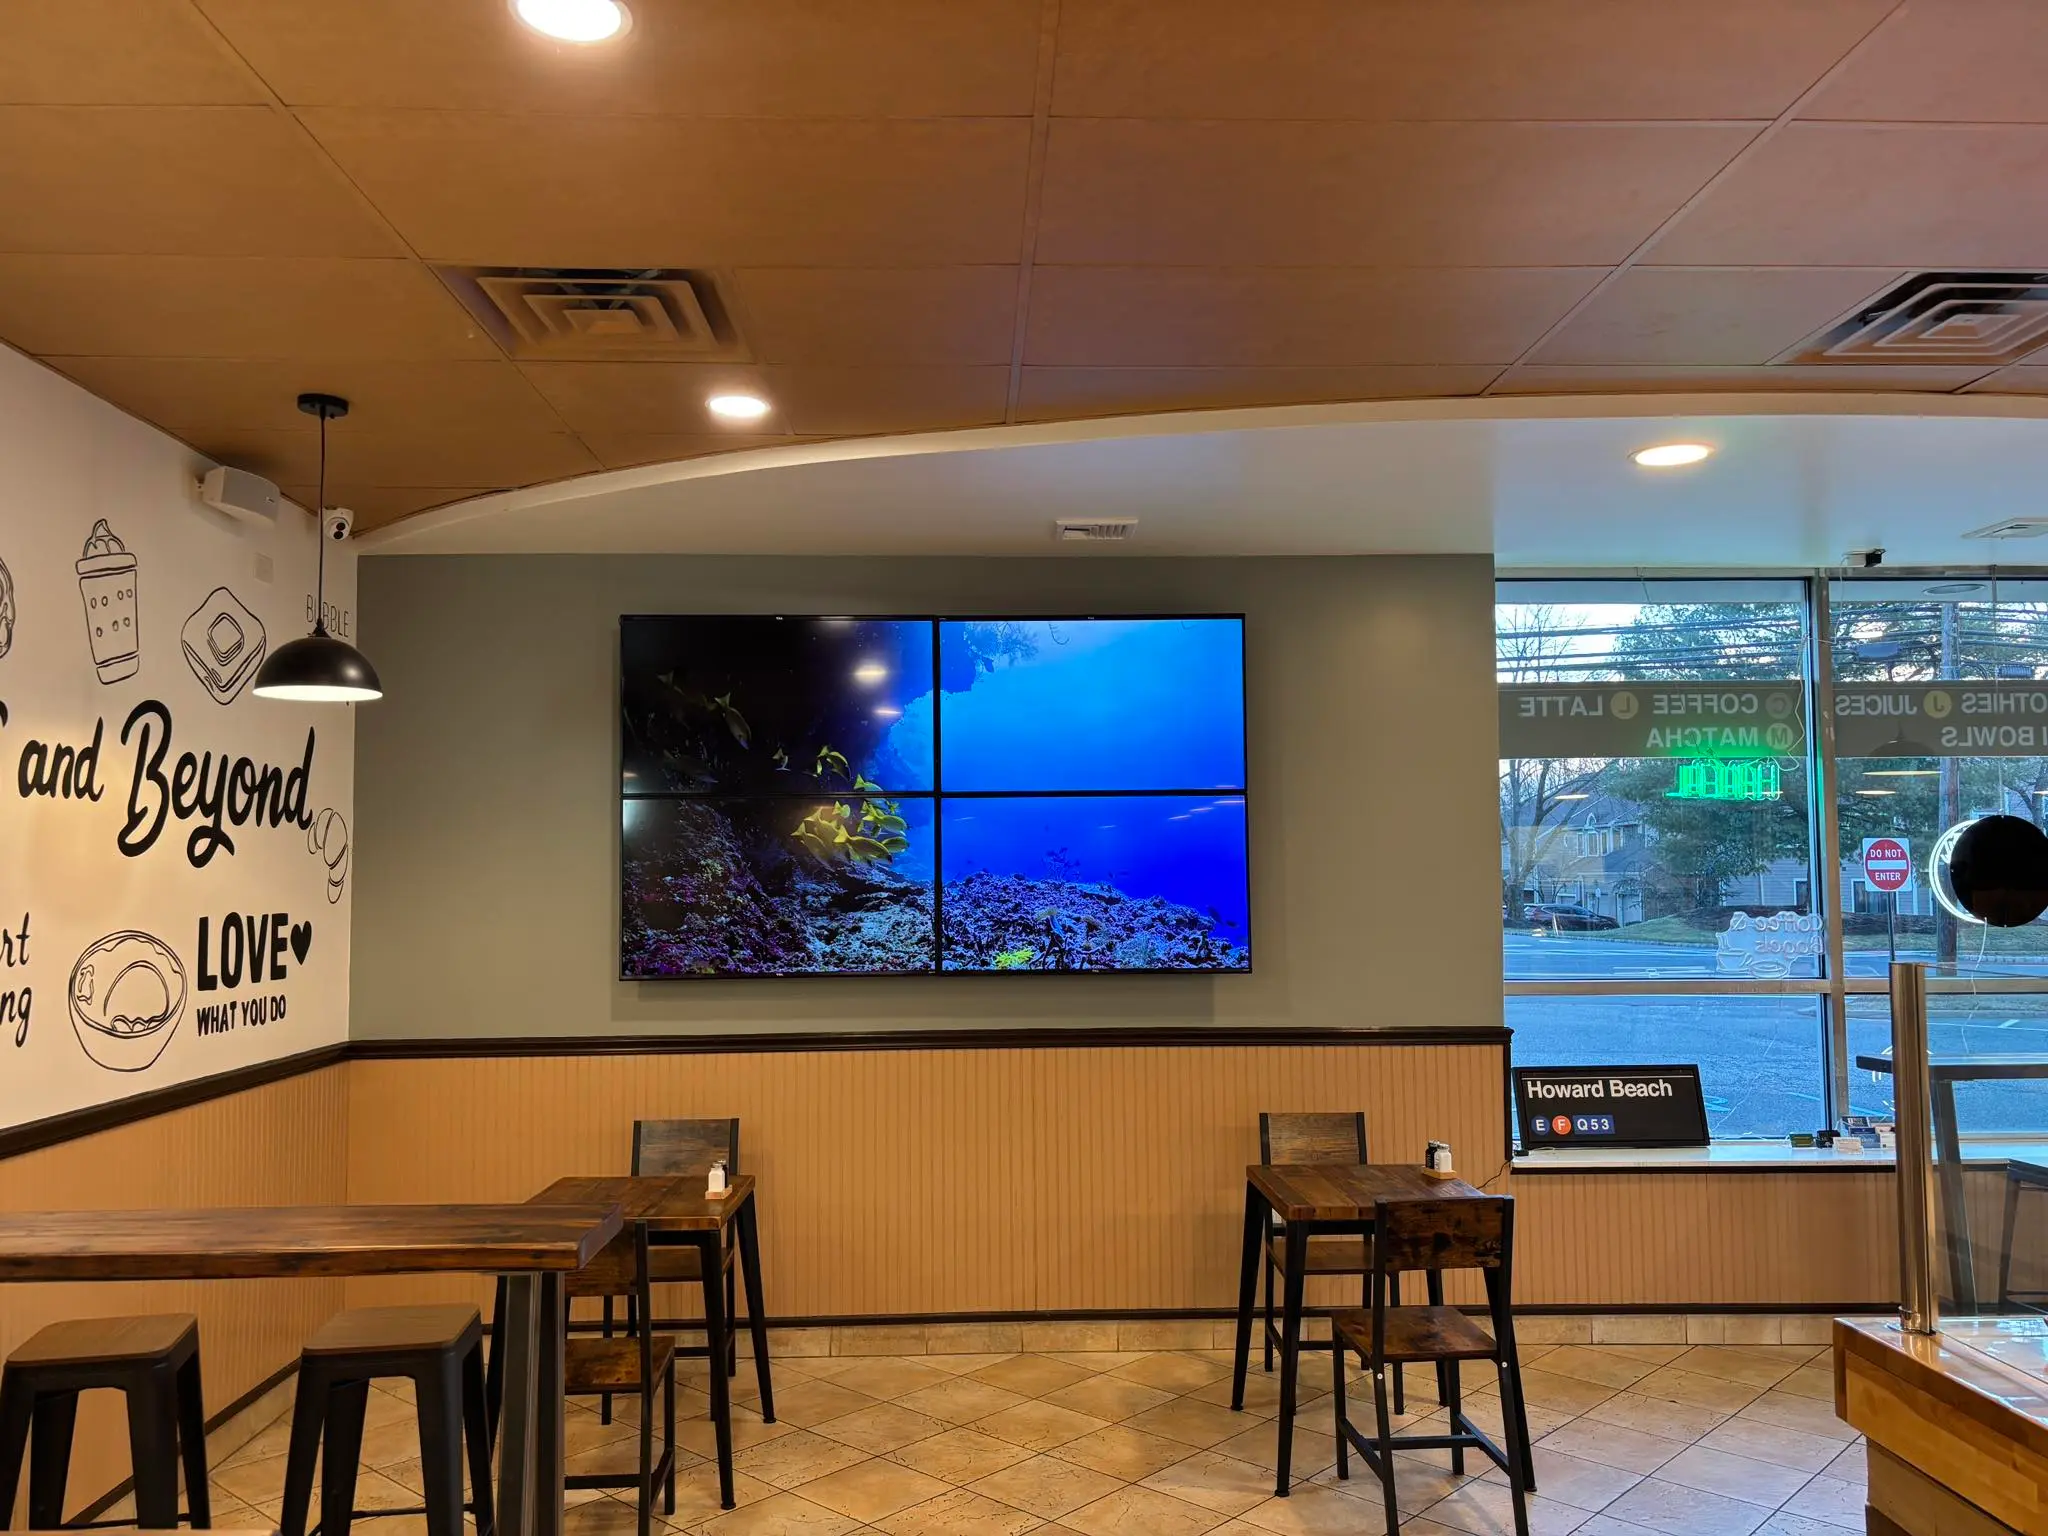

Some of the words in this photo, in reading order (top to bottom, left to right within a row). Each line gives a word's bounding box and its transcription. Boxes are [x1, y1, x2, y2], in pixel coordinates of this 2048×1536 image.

[18, 716, 104, 802] and
[117, 699, 315, 868] Beyond
[1870, 849, 1882, 858] DO
[1885, 849, 1902, 858] NOT
[1875, 872, 1901, 881] ENTER
[197, 911, 289, 991] LOVE
[197, 1001, 237, 1037] WHAT
[241, 996, 267, 1027] YOU
[270, 994, 287, 1022] DO
[1527, 1080, 1605, 1099] Howard
[1609, 1079, 1673, 1098] Beach
